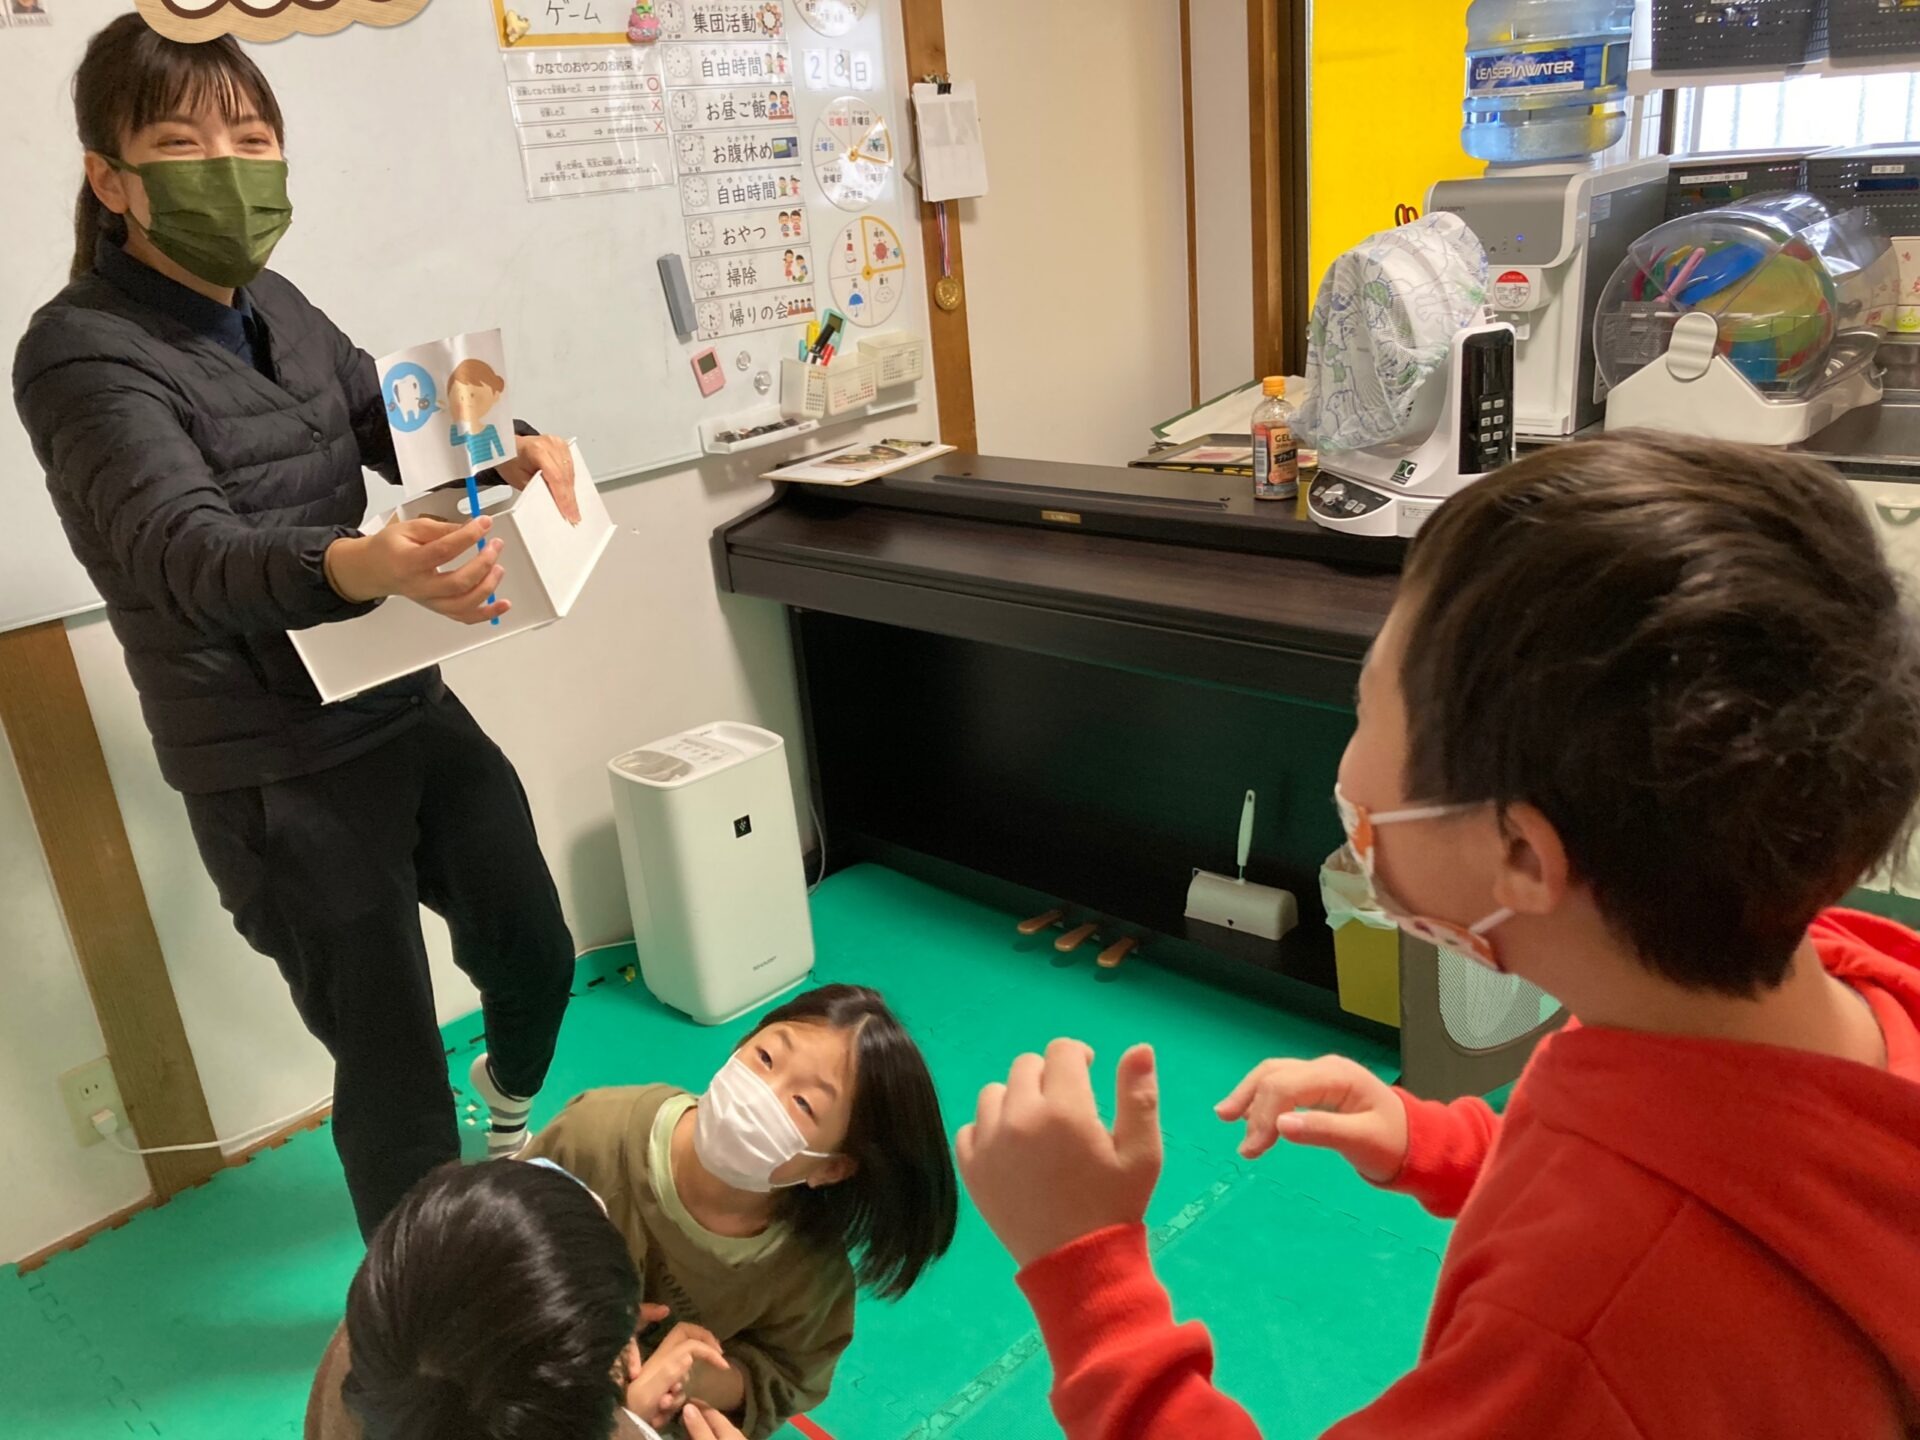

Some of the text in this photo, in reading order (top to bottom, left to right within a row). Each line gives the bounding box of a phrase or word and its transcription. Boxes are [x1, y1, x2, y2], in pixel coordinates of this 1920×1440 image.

[546, 0, 602, 26] ゲーム
[693, 11, 757, 34] 集団活動
[701, 57, 763, 77] 自由時間
[706, 100, 768, 121] お昼ご飯
[712, 142, 773, 164] お腹休め
[717, 180, 777, 205] 自由時間
[722, 225, 767, 245] おやつ
[726, 265, 758, 288] 掃除
[729, 302, 788, 328] 帰りの会
